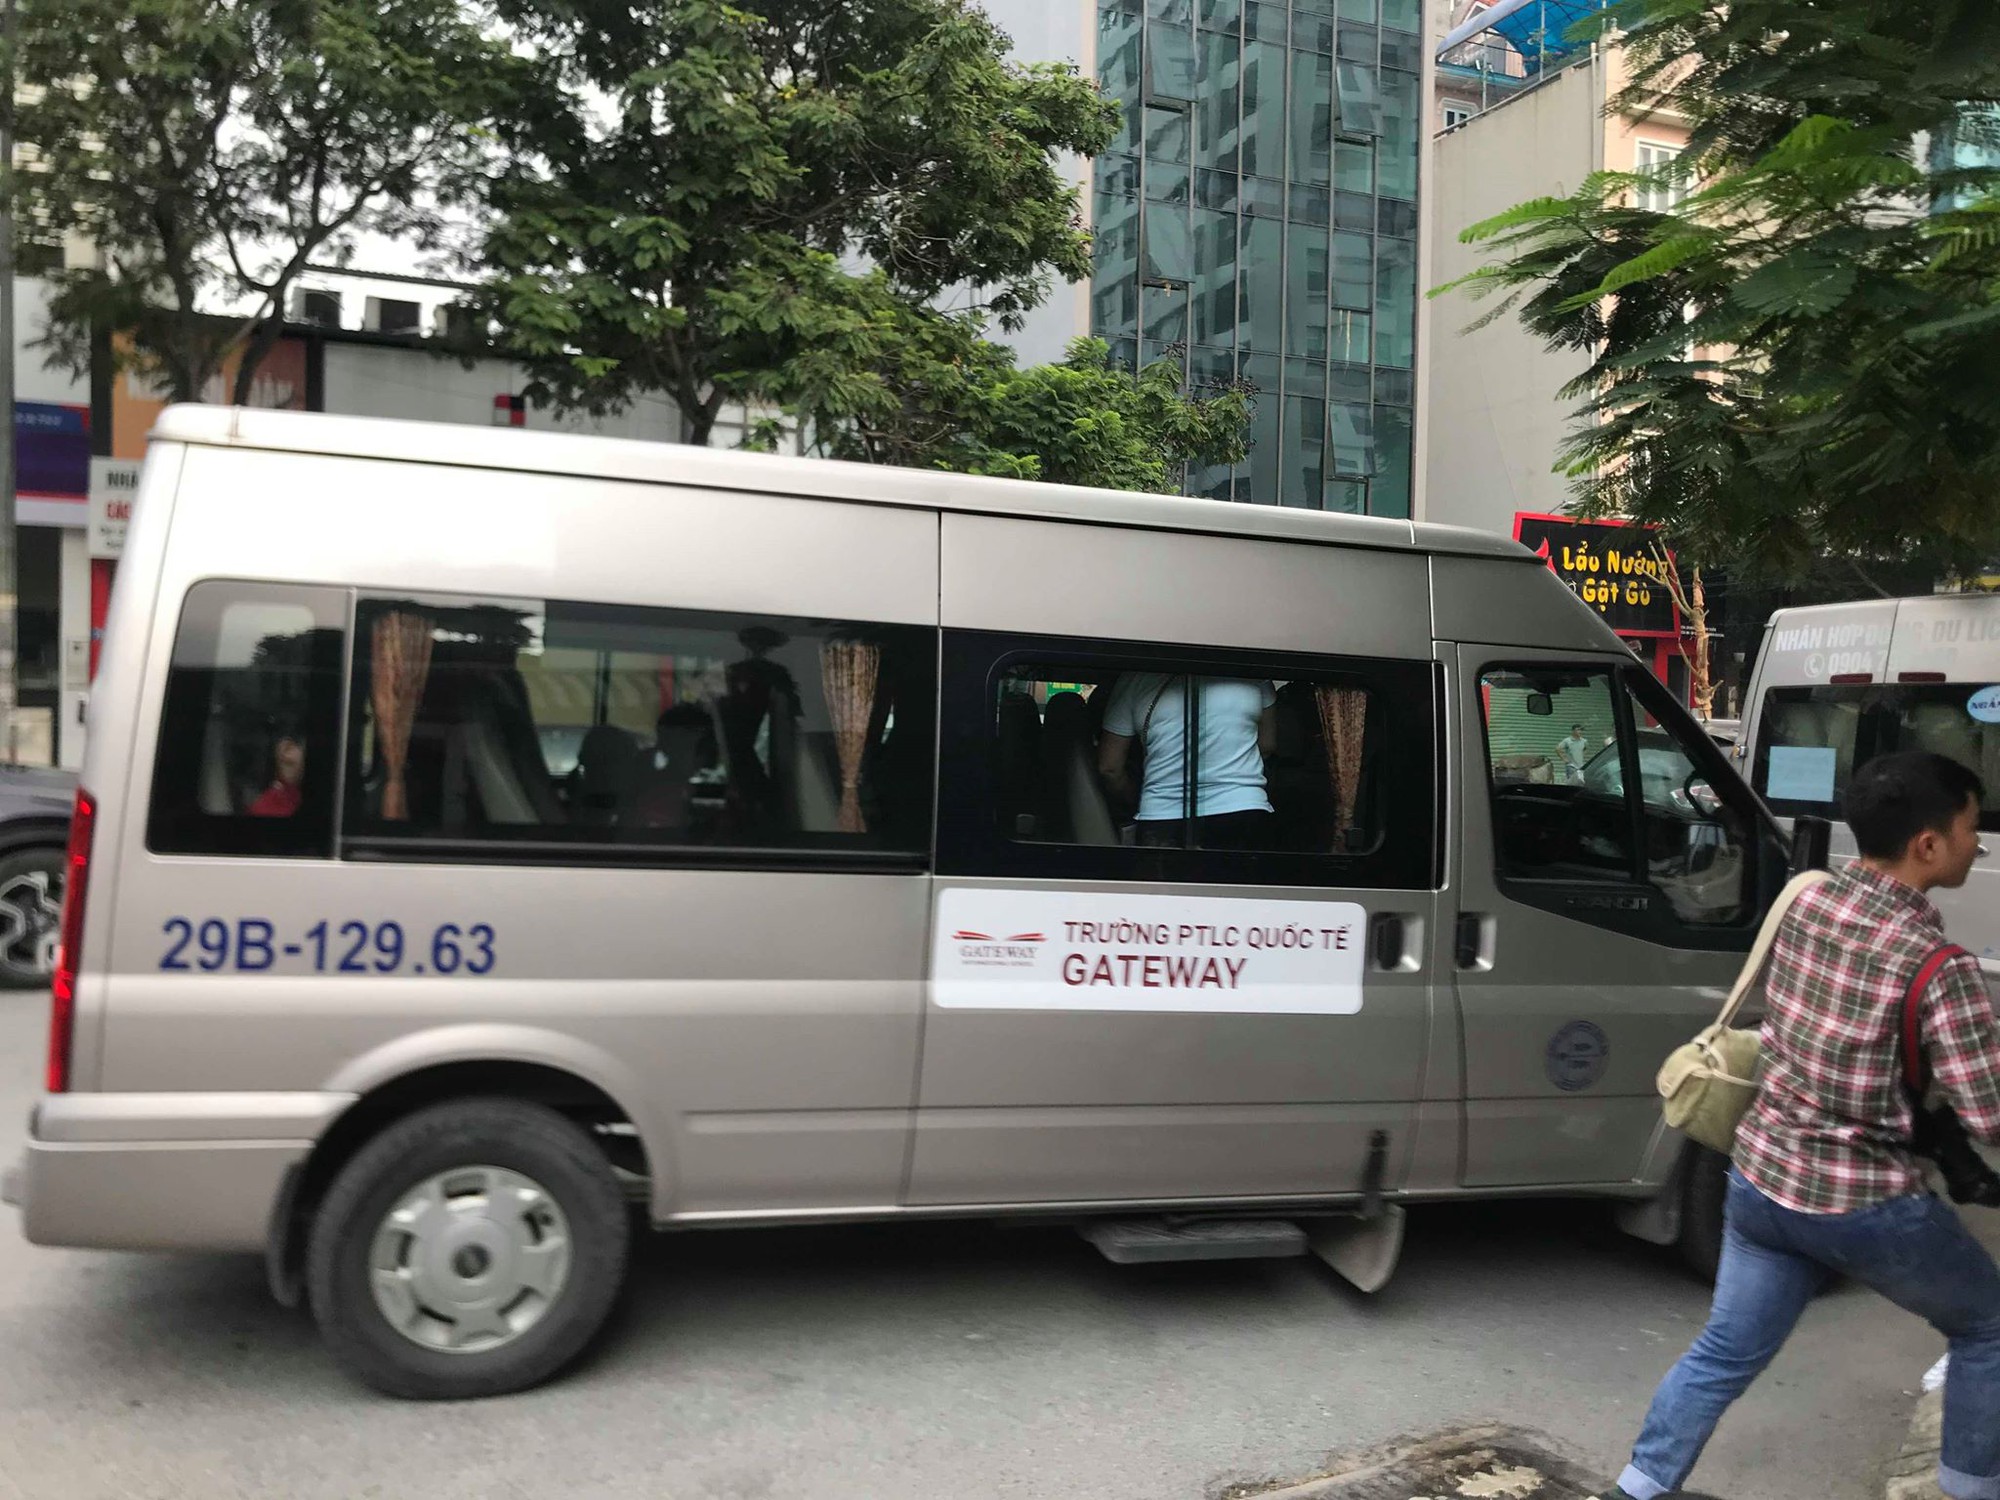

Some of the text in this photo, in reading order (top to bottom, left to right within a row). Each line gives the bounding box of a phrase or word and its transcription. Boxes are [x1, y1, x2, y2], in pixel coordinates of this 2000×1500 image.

[1562, 540, 1669, 583] Lẩu Nướng
[1582, 577, 1619, 612] Gật
[1626, 580, 1651, 606] Gù
[1827, 651, 1872, 675] 0904
[159, 917, 496, 974] 29B-129.63
[1063, 917, 1352, 950] TRƯỜNG PTLC QUỐC TẾ
[960, 944, 1039, 959] GATEWAY
[1062, 953, 1247, 989] GATEWAY
